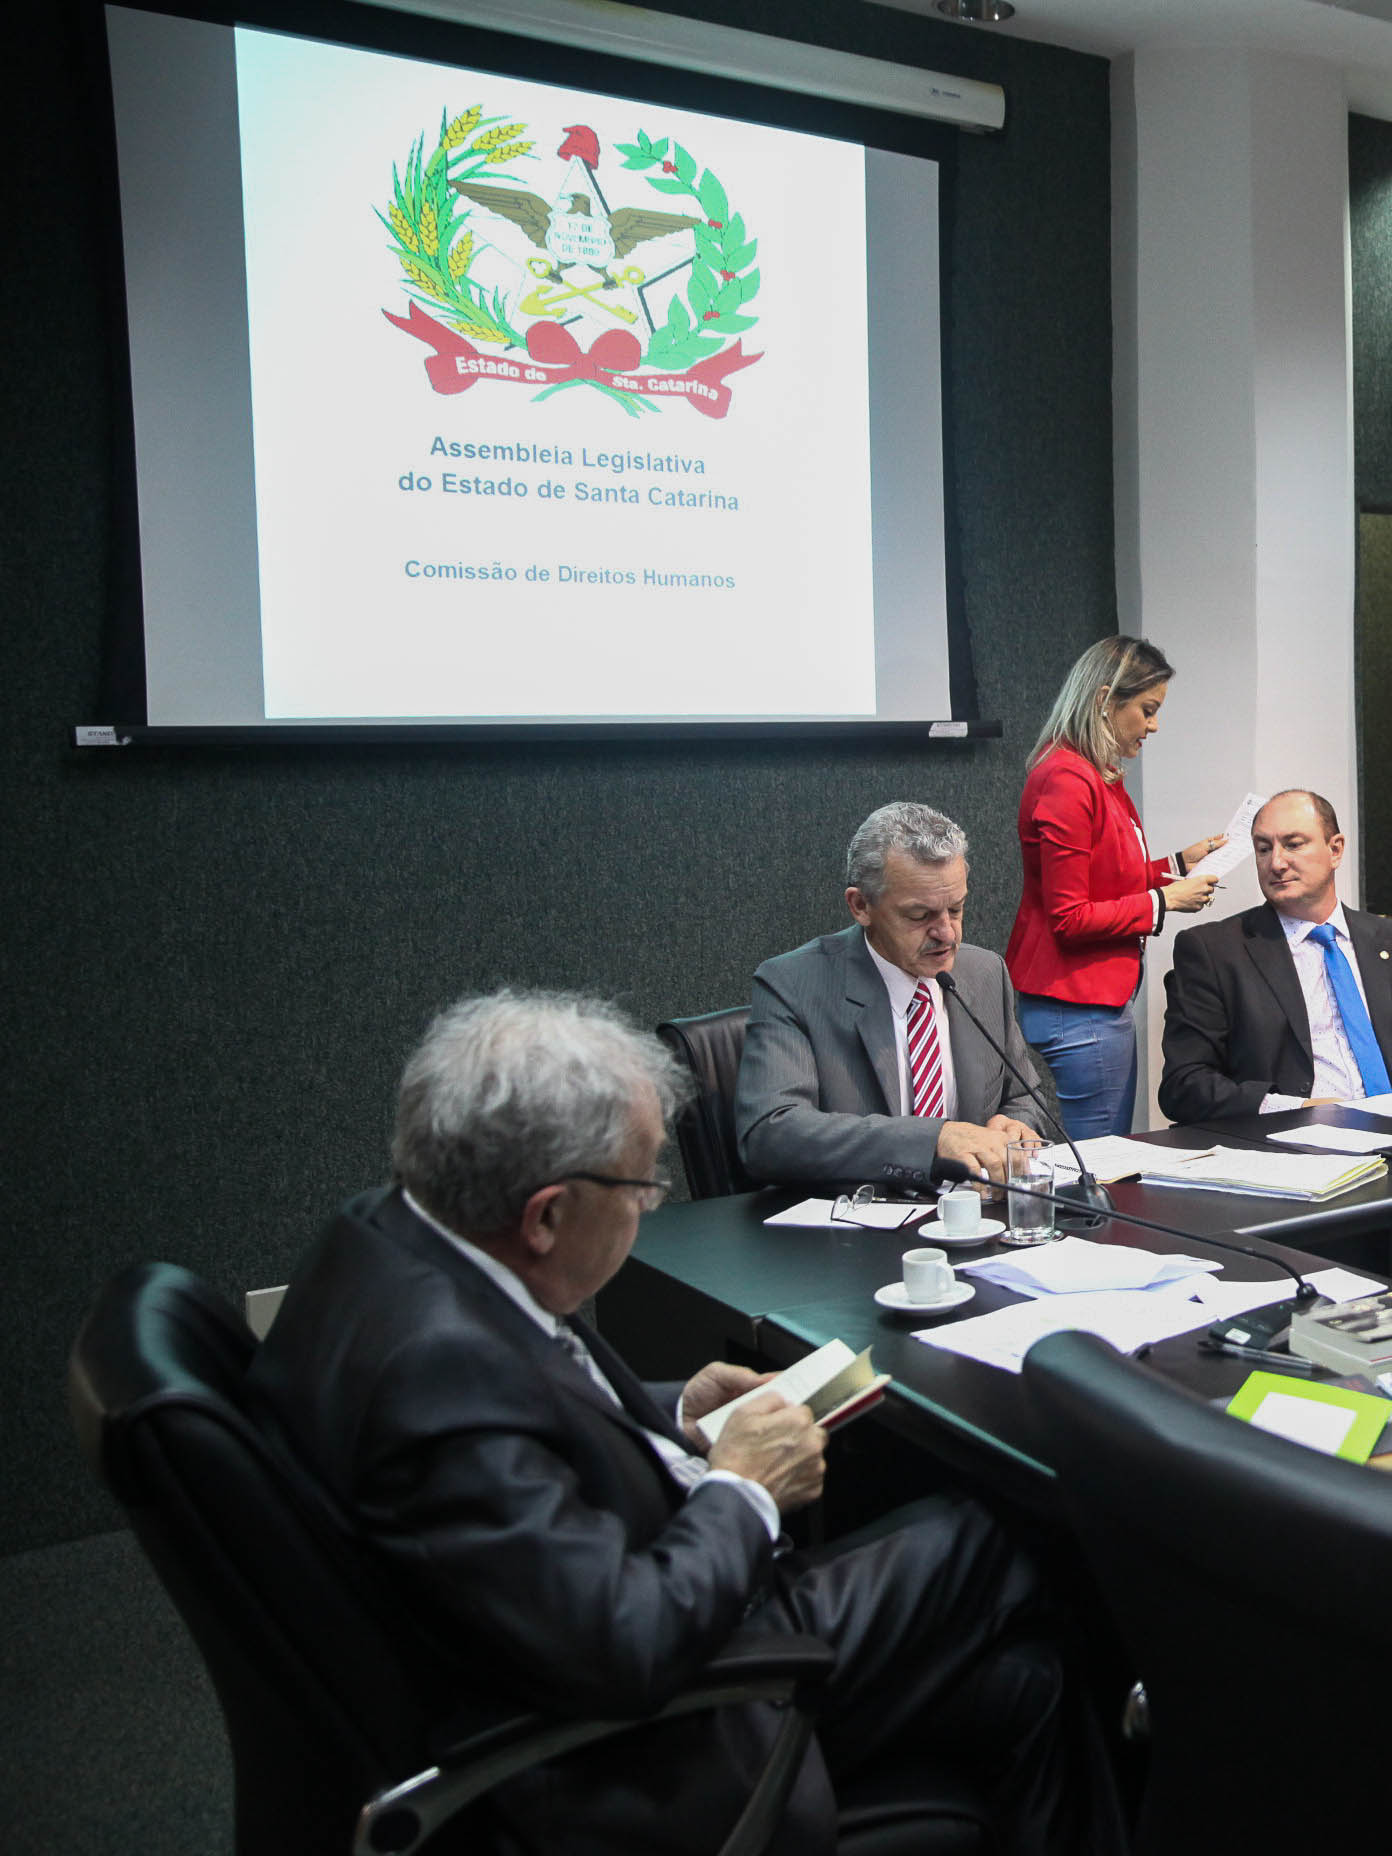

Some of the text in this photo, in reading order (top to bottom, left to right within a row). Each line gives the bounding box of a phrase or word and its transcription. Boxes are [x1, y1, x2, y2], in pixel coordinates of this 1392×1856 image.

[455, 356, 719, 401] Estado de Sta. Catarina
[430, 436, 706, 475] Assembleia Legislativa
[398, 472, 740, 511] do Estado de Santa Catarina
[404, 560, 736, 589] Comissão de Direitos Humanos
